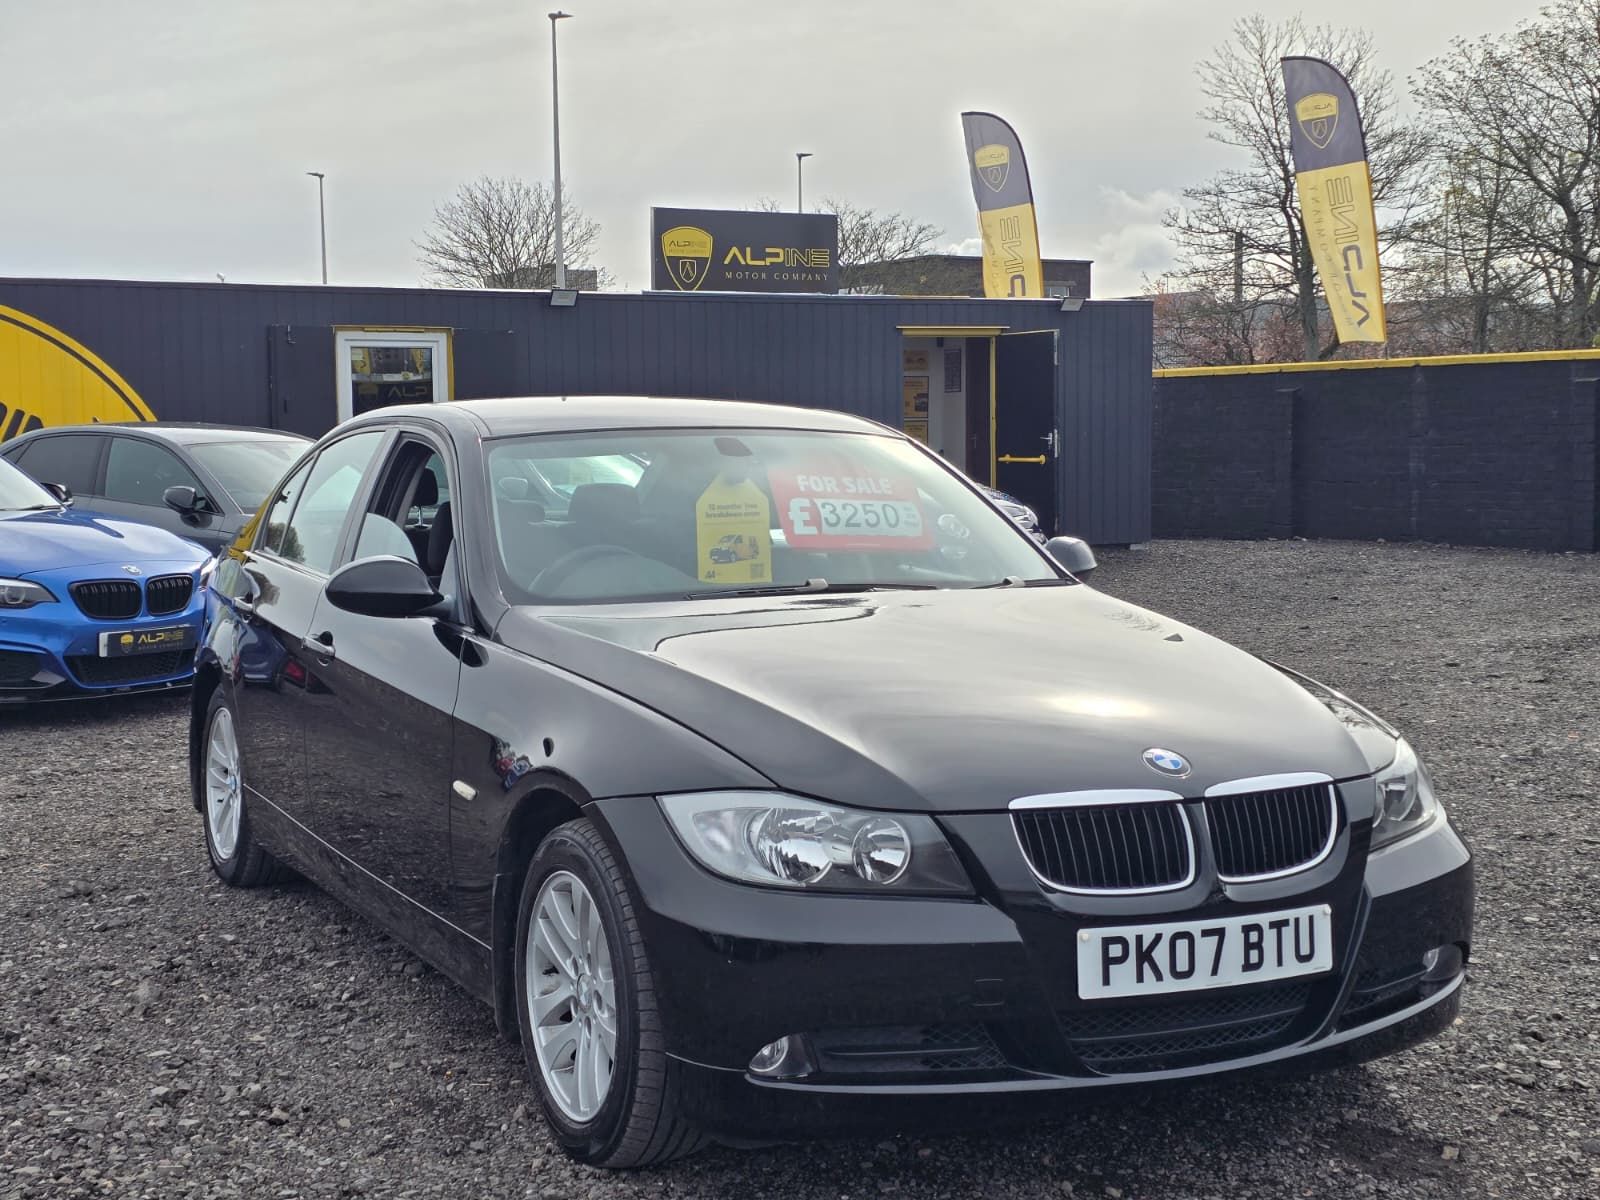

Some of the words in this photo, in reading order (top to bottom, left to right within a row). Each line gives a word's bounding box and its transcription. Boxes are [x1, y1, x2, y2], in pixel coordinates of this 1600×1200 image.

[723, 246, 830, 268] ALPINE
[725, 271, 767, 280] MOTOR
[773, 272, 829, 281] COMPANY
[797, 474, 840, 493] FOR
[842, 477, 893, 495] SALE
[1101, 927, 1227, 987] PK07
[1241, 914, 1315, 973] BTU
